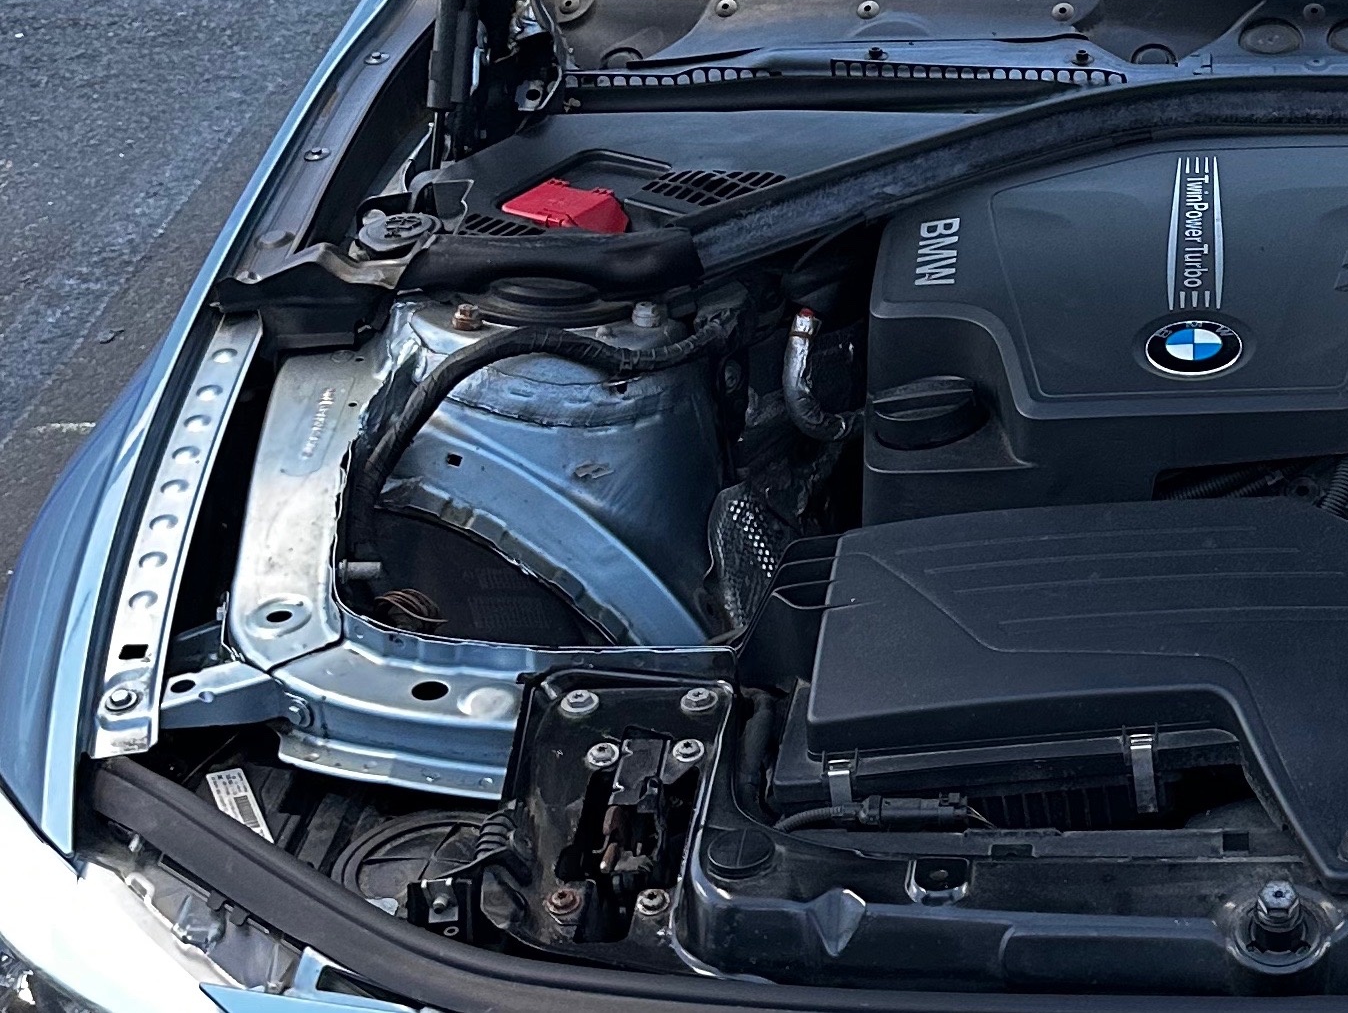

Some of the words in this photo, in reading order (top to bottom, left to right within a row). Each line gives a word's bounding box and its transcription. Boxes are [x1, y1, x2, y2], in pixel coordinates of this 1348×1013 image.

[1184, 174, 1210, 241] TwinPower
[914, 217, 960, 286] BMW
[1183, 243, 1210, 288] Turbo
